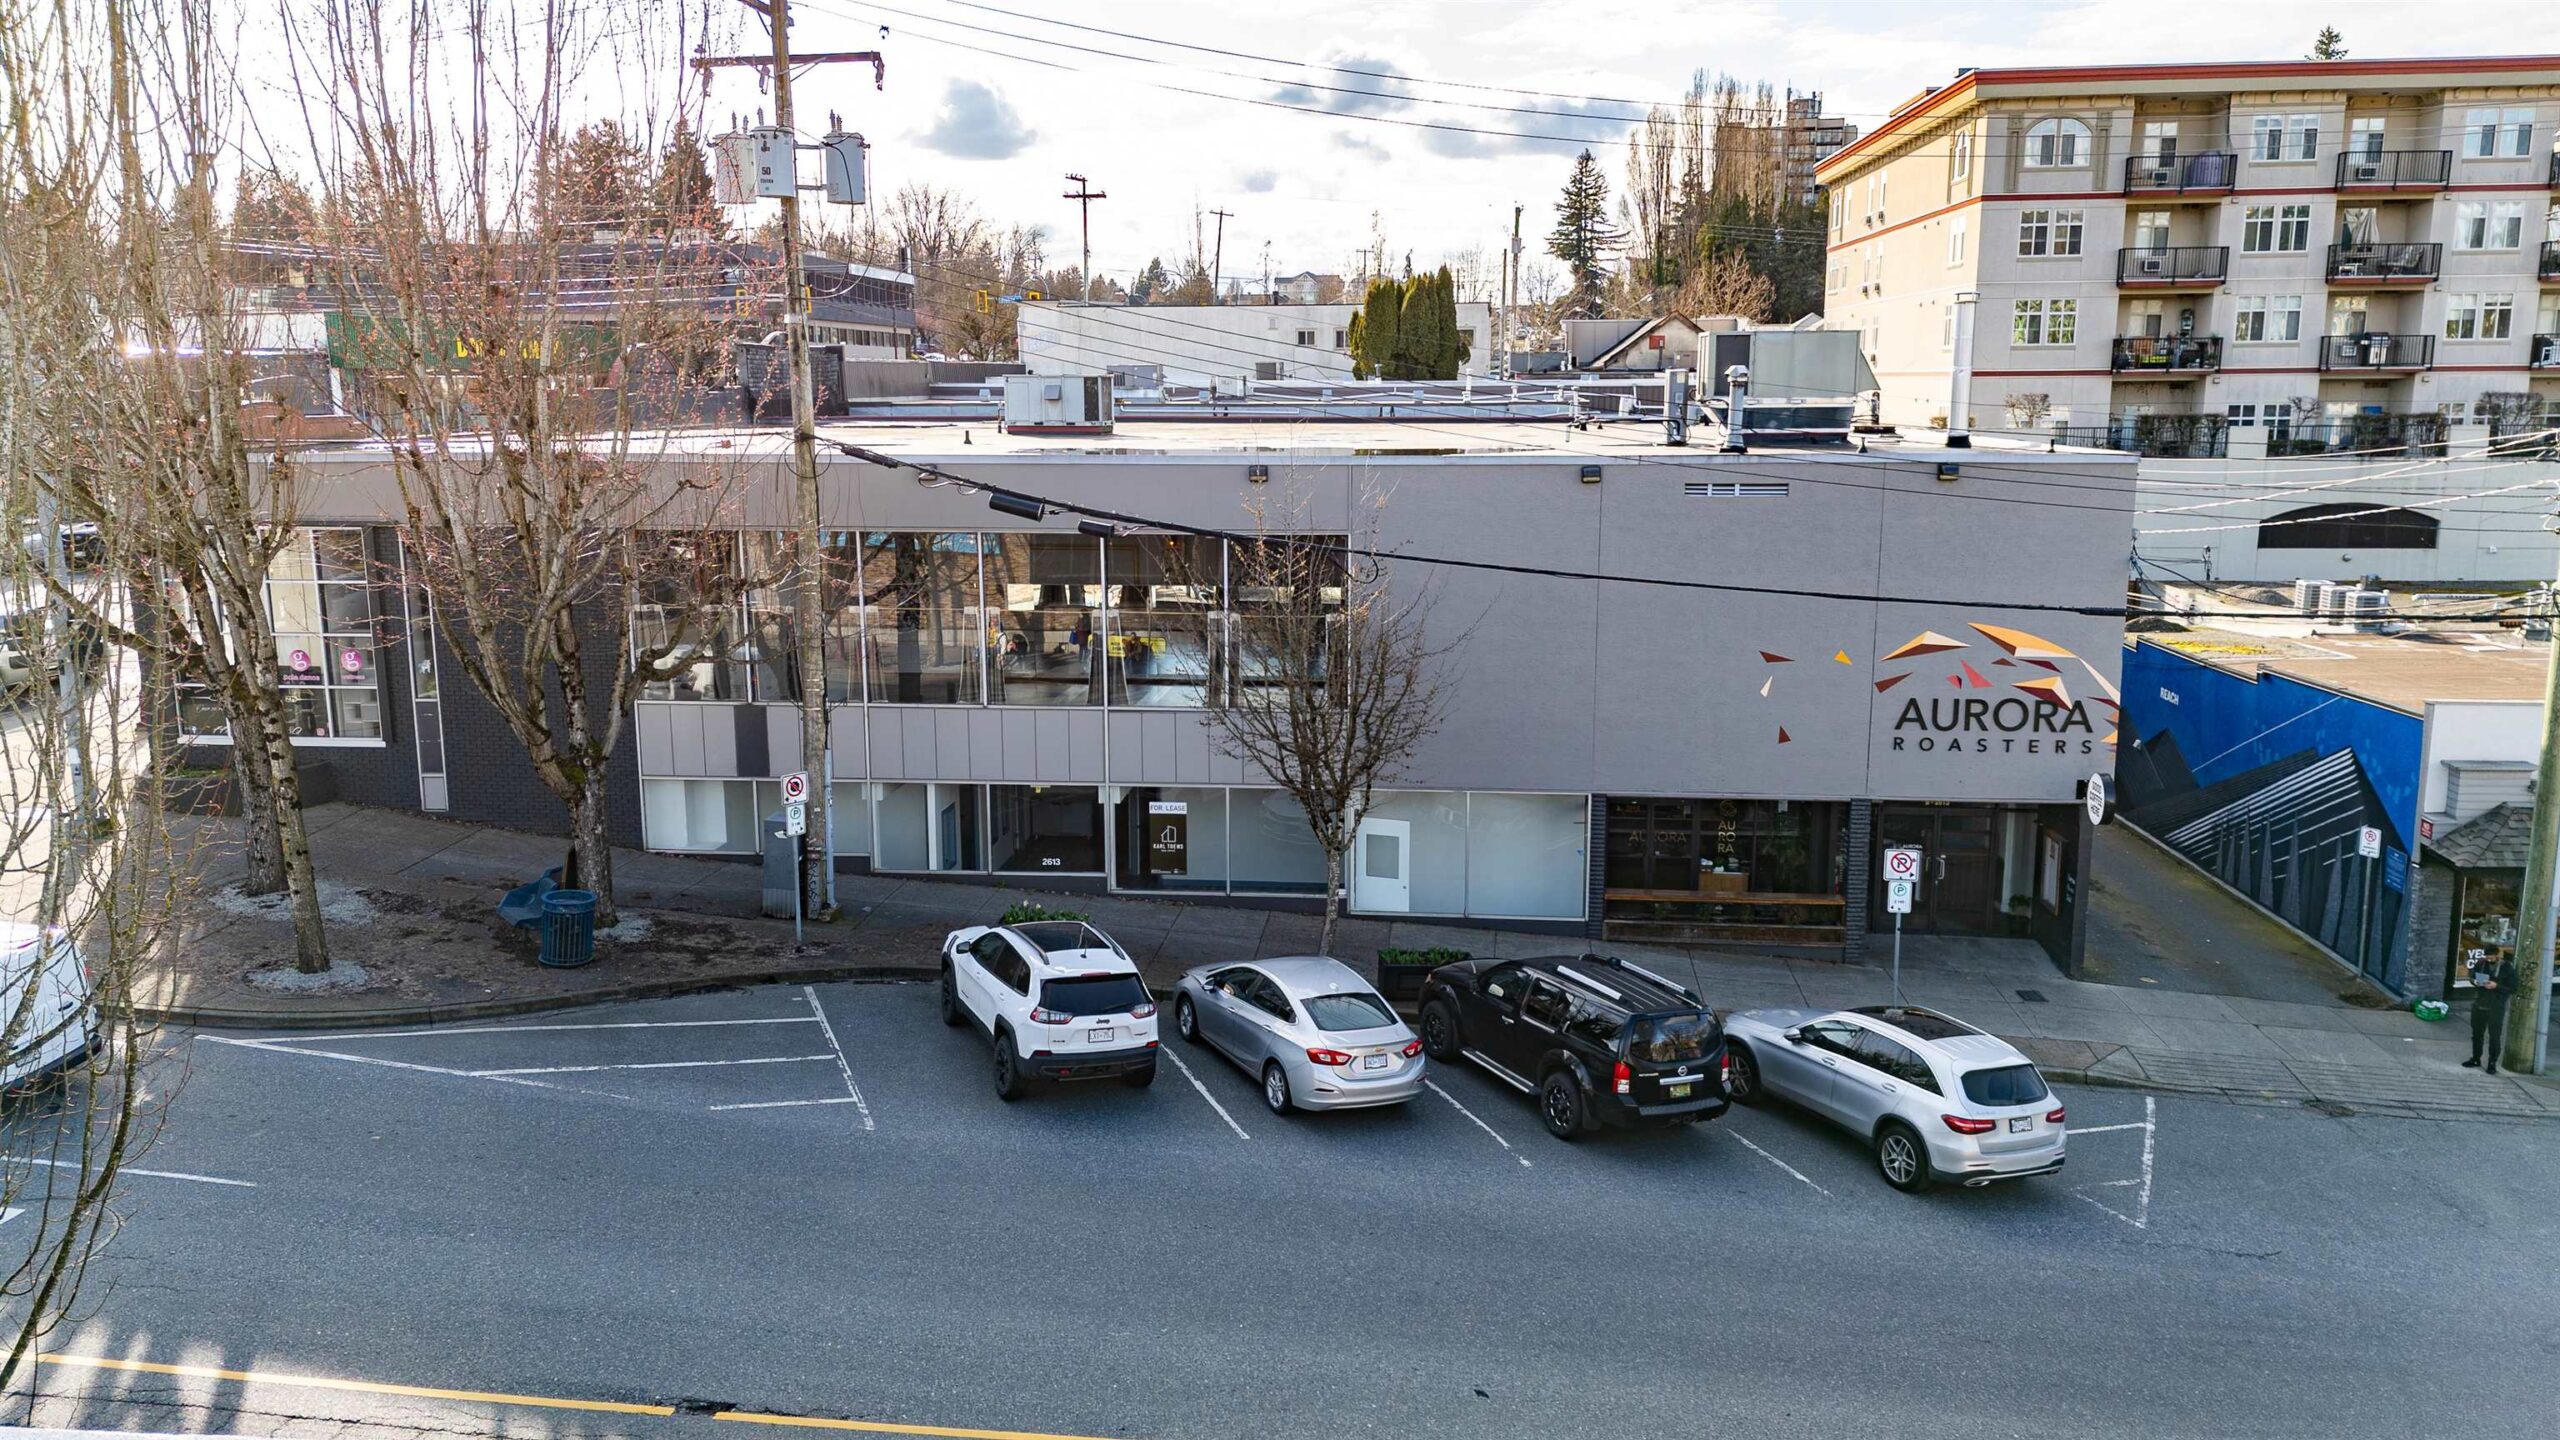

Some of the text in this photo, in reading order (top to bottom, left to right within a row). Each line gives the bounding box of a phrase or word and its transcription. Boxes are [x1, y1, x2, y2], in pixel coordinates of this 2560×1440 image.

[761, 166, 771, 175] 50
[2160, 686, 2179, 705] REACH
[1893, 697, 2094, 733] AURORA
[1893, 736, 2093, 754] ROASTERS
[1150, 804, 1185, 812] FOR LEASE
[1718, 820, 1736, 830] AU
[1718, 832, 1736, 842] RO
[1717, 843, 1734, 853] RA
[1042, 858, 1061, 866] 2613
